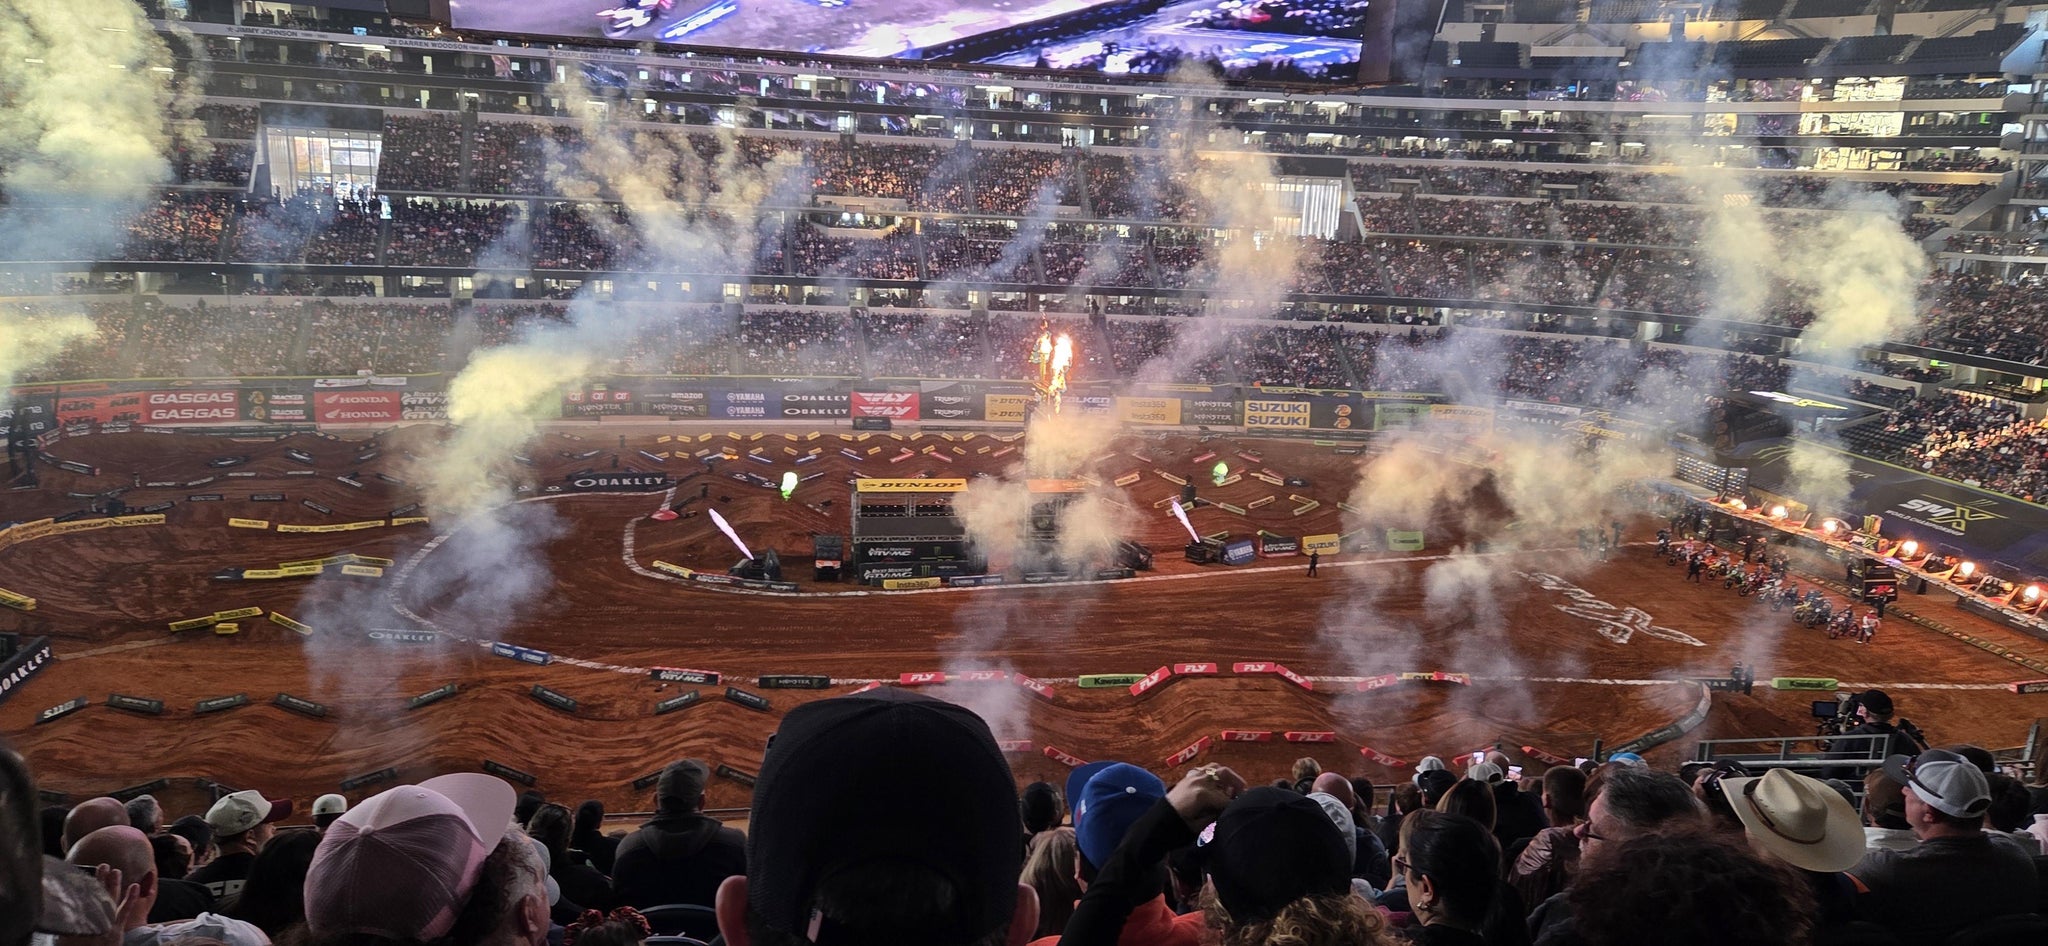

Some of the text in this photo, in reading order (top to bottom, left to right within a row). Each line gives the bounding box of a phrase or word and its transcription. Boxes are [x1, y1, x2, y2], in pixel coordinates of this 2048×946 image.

[261, 28, 298, 37] JOHNSON
[431, 42, 468, 50] WOODSON
[150, 392, 234, 404] GASGAS
[339, 396, 390, 404] HONDA
[670, 392, 703, 400] amazon
[736, 393, 765, 401] YAMAHA
[1194, 400, 1232, 408] MONSTER
[1248, 402, 1307, 413] SUZUKI
[151, 408, 235, 420] GASGAS
[339, 411, 391, 419] HONDA
[736, 406, 765, 414] YAMAHA
[1247, 415, 1307, 426] SUZUKI
[599, 477, 664, 486] OAKLEY
[878, 481, 963, 489] DUNLOP
[386, 633, 433, 641] OAKLEY
[2, 646, 50, 690] OAKLEY
[1184, 663, 1208, 673] FLY
[1243, 663, 1267, 673] FLY
[910, 672, 935, 682] FLY
[970, 672, 994, 681] FLY
[1094, 676, 1135, 686] Kawasaki
[1022, 679, 1046, 692] FLY
[1139, 673, 1160, 691] FLY
[1367, 677, 1388, 689] FLY
[1235, 731, 1260, 741] FLY
[1298, 732, 1323, 741] FLY
[1055, 749, 1080, 766] FLY
[1177, 744, 1199, 762] FLY
[1372, 751, 1396, 766] FLY
